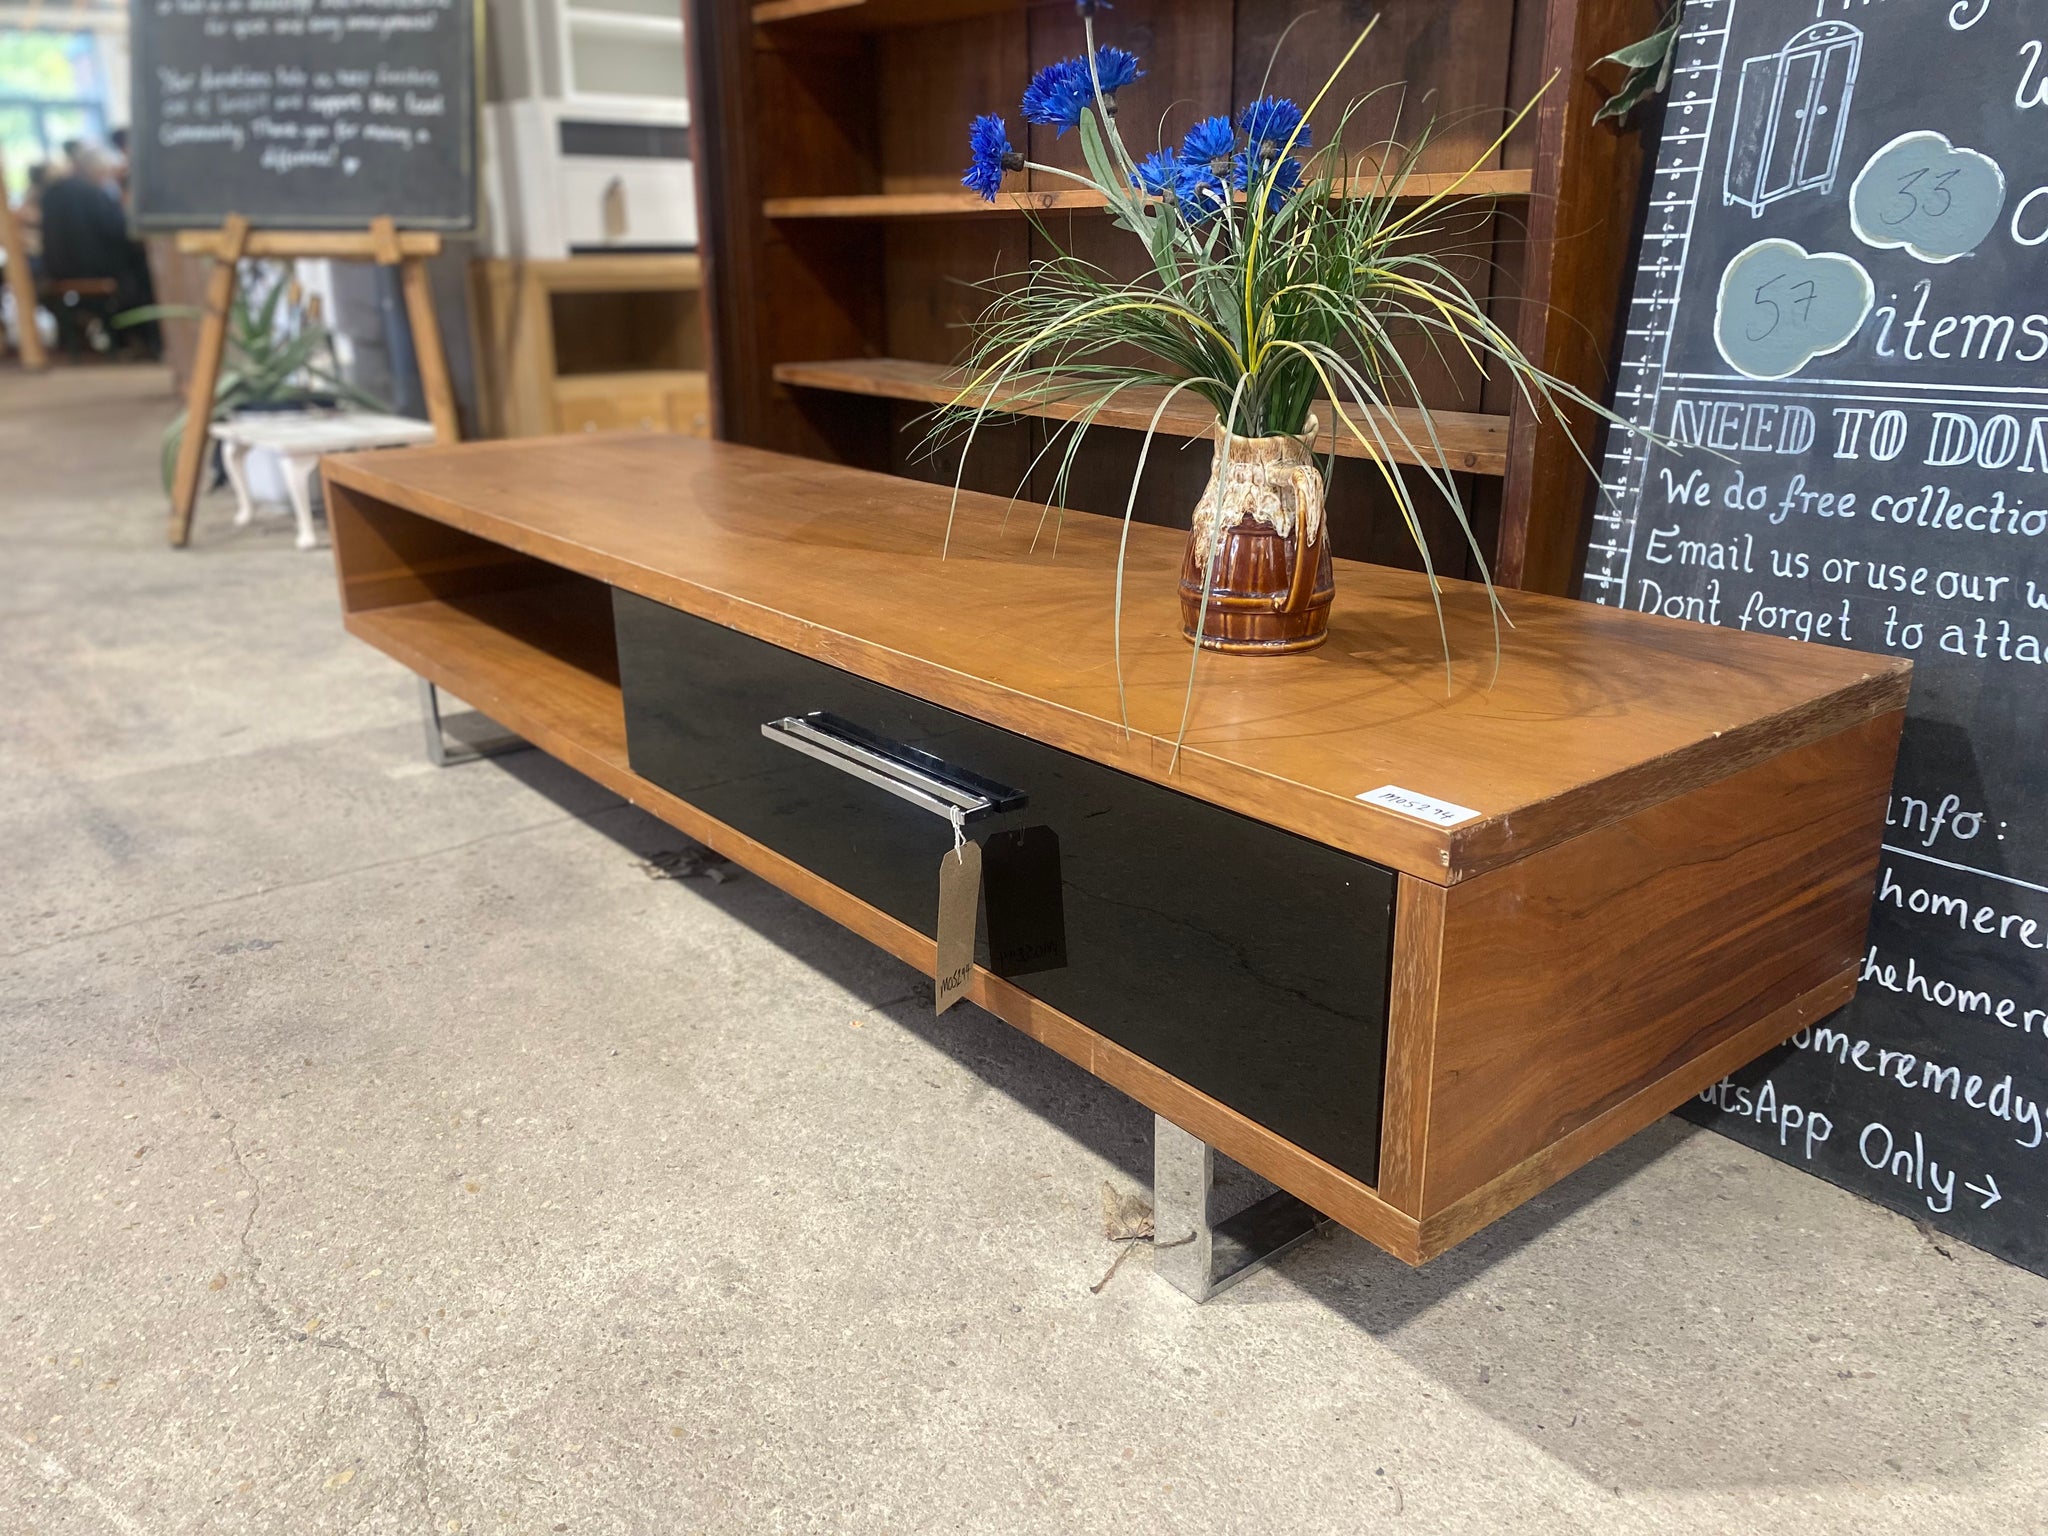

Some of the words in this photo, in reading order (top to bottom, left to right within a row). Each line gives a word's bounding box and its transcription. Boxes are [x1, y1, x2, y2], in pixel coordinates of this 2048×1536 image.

[1880, 168, 1961, 225] 33
[1746, 273, 1817, 342] 57
[1875, 279, 2048, 362] items
[1667, 399, 1816, 455] NEED
[1833, 408, 1908, 461] TO
[1660, 468, 1711, 506] We
[1724, 470, 1767, 512] do
[1769, 473, 1856, 525] free
[1871, 485, 2048, 537] collectio
[1646, 525, 1754, 573] Email
[1770, 548, 1810, 580] us
[1822, 557, 1861, 584] or
[1867, 563, 1926, 596] use
[1935, 571, 2010, 602] our
[1738, 590, 1852, 643] forget
[1884, 605, 1924, 650] to
[1939, 617, 2048, 664] atta
[1879, 867, 2048, 950] homere
[1857, 945, 2048, 1039] hehomer
[1781, 1025, 2048, 1148] omeremedy
[1859, 1122, 1955, 1213] Only
